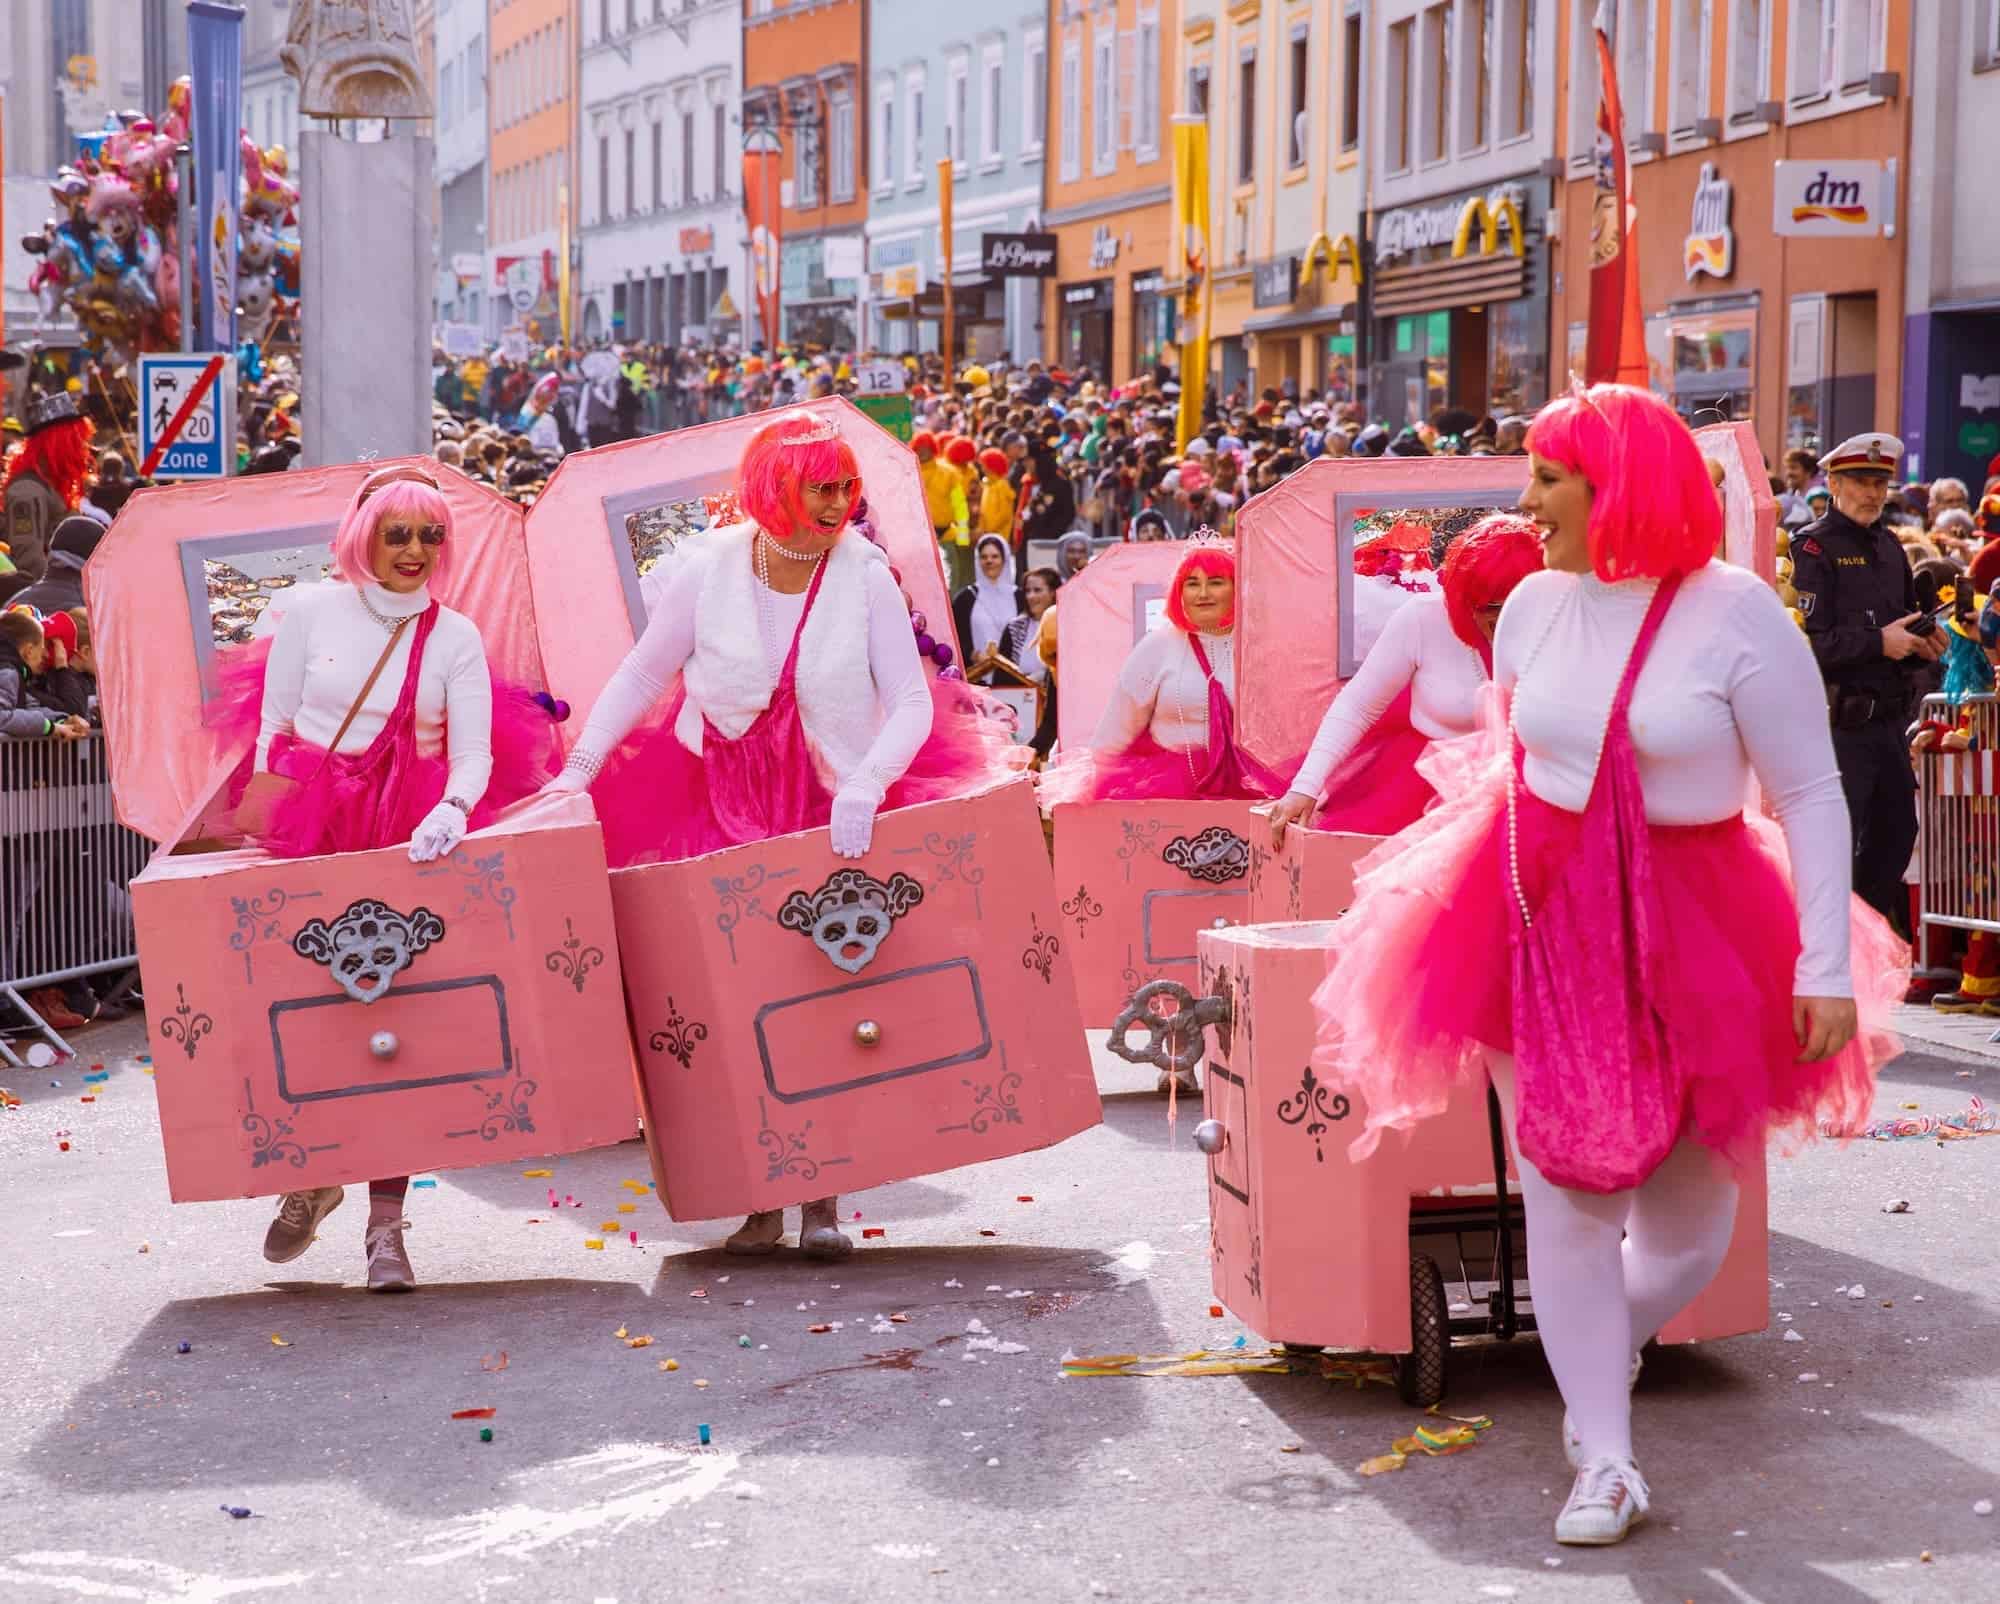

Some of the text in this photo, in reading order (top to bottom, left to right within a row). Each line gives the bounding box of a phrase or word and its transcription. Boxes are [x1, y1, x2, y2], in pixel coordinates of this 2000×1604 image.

[1804, 171, 1861, 204] dm
[868, 372, 892, 389] 12
[188, 416, 209, 437] 20
[157, 448, 208, 468] Zone
